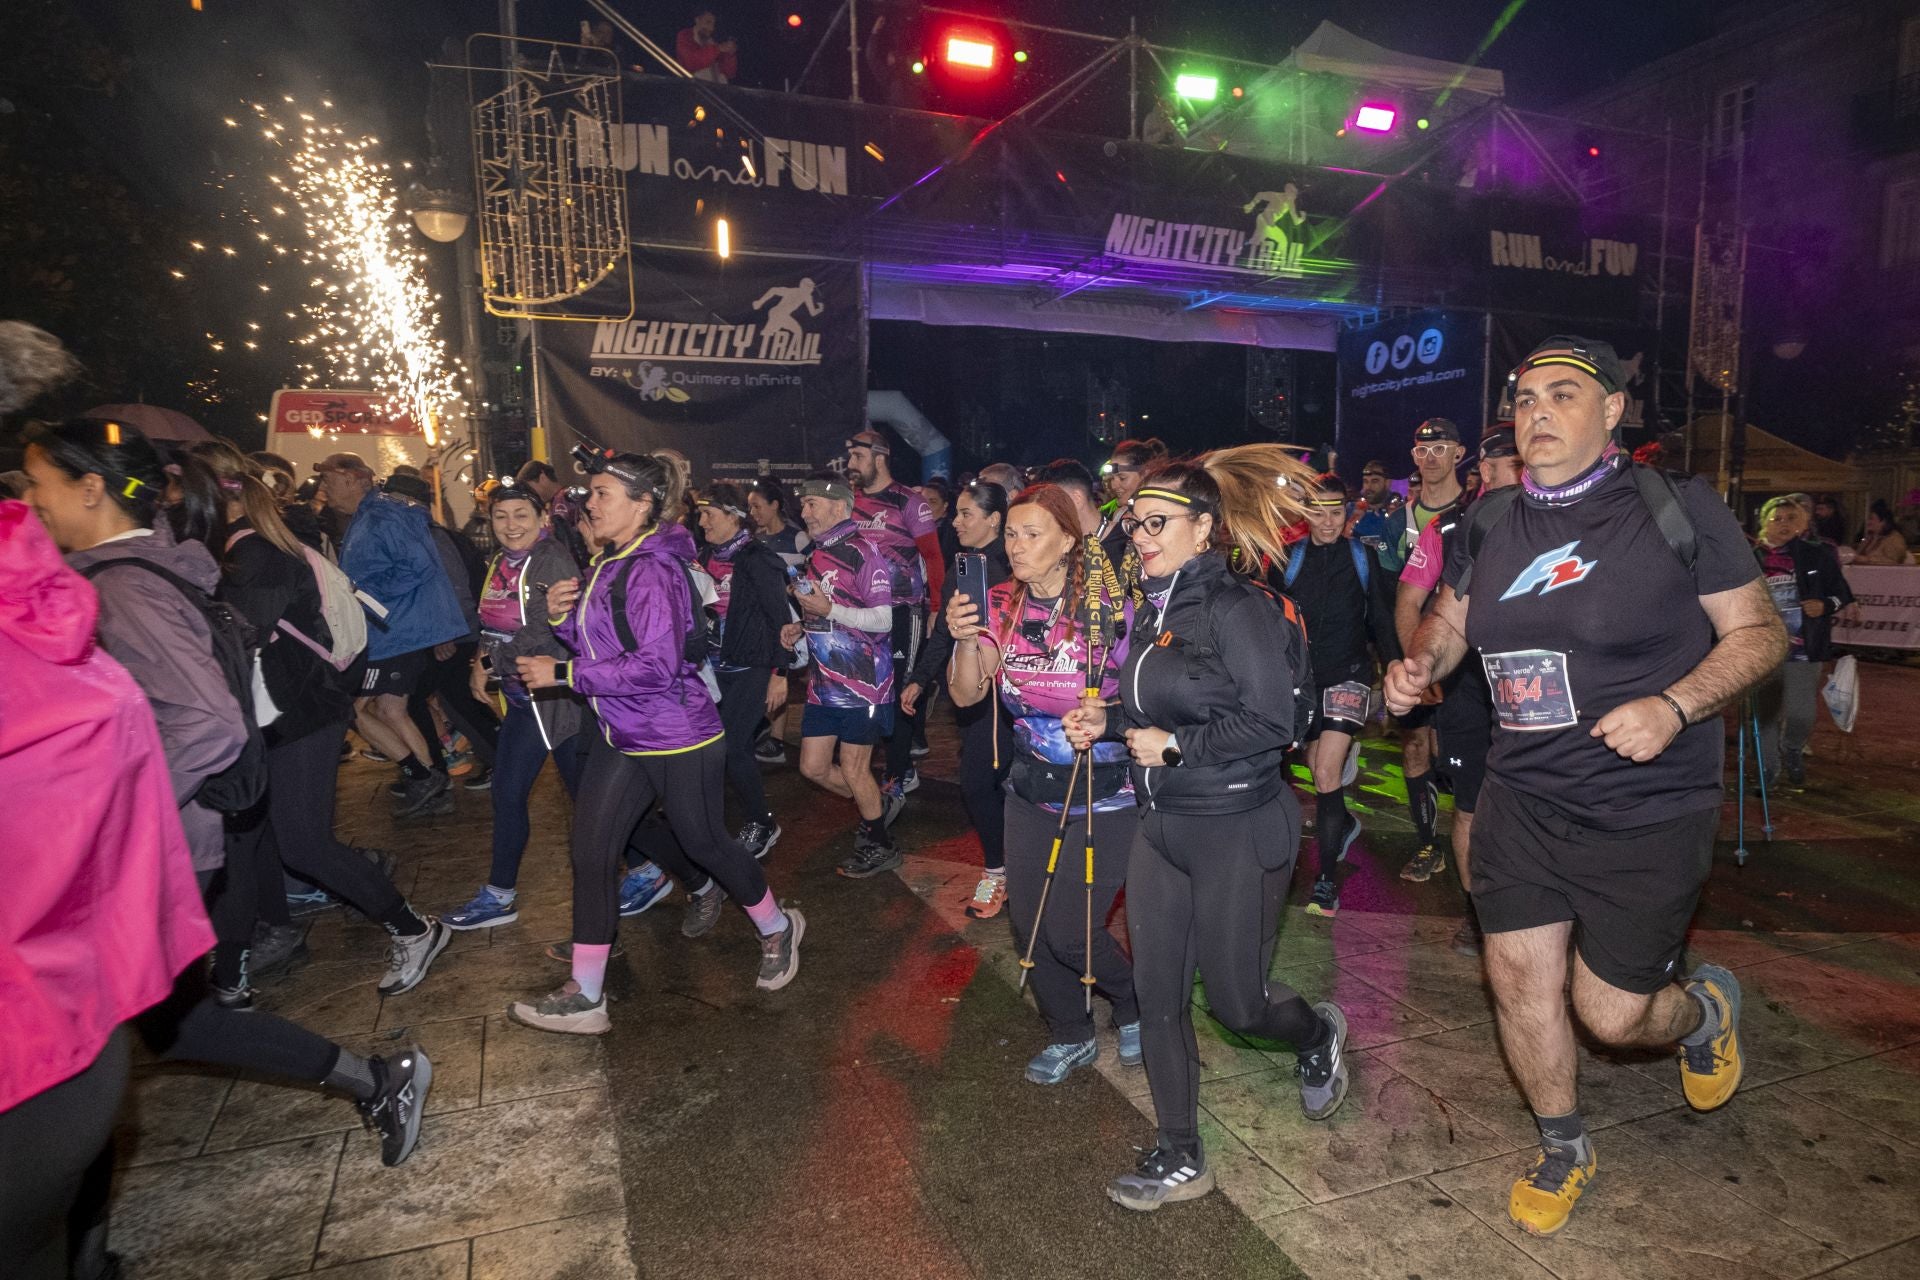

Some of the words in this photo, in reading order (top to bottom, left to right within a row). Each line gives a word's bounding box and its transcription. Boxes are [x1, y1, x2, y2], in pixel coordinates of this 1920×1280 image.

[576, 116, 669, 176] RUN
[673, 138, 763, 187] and
[764, 136, 848, 195] FUN
[1104, 212, 1246, 267] NIGHTCITY
[1247, 240, 1304, 271] TRAIL
[1490, 230, 1543, 269] RUN
[1543, 240, 1591, 276] and
[1590, 238, 1638, 275] FUN
[592, 318, 756, 359] NIGHTCITY
[759, 331, 822, 361] TRAIL
[590, 366, 618, 378] BY:
[672, 371, 740, 386] Quimera
[744, 374, 801, 386] Infinita
[1351, 368, 1466, 398] nightcitytrail.com
[1089, 573, 1102, 606] GRIVEL
[1052, 659, 1078, 672] TRAIL
[1046, 680, 1077, 688] Infinita
[1497, 675, 1543, 704] 1054
